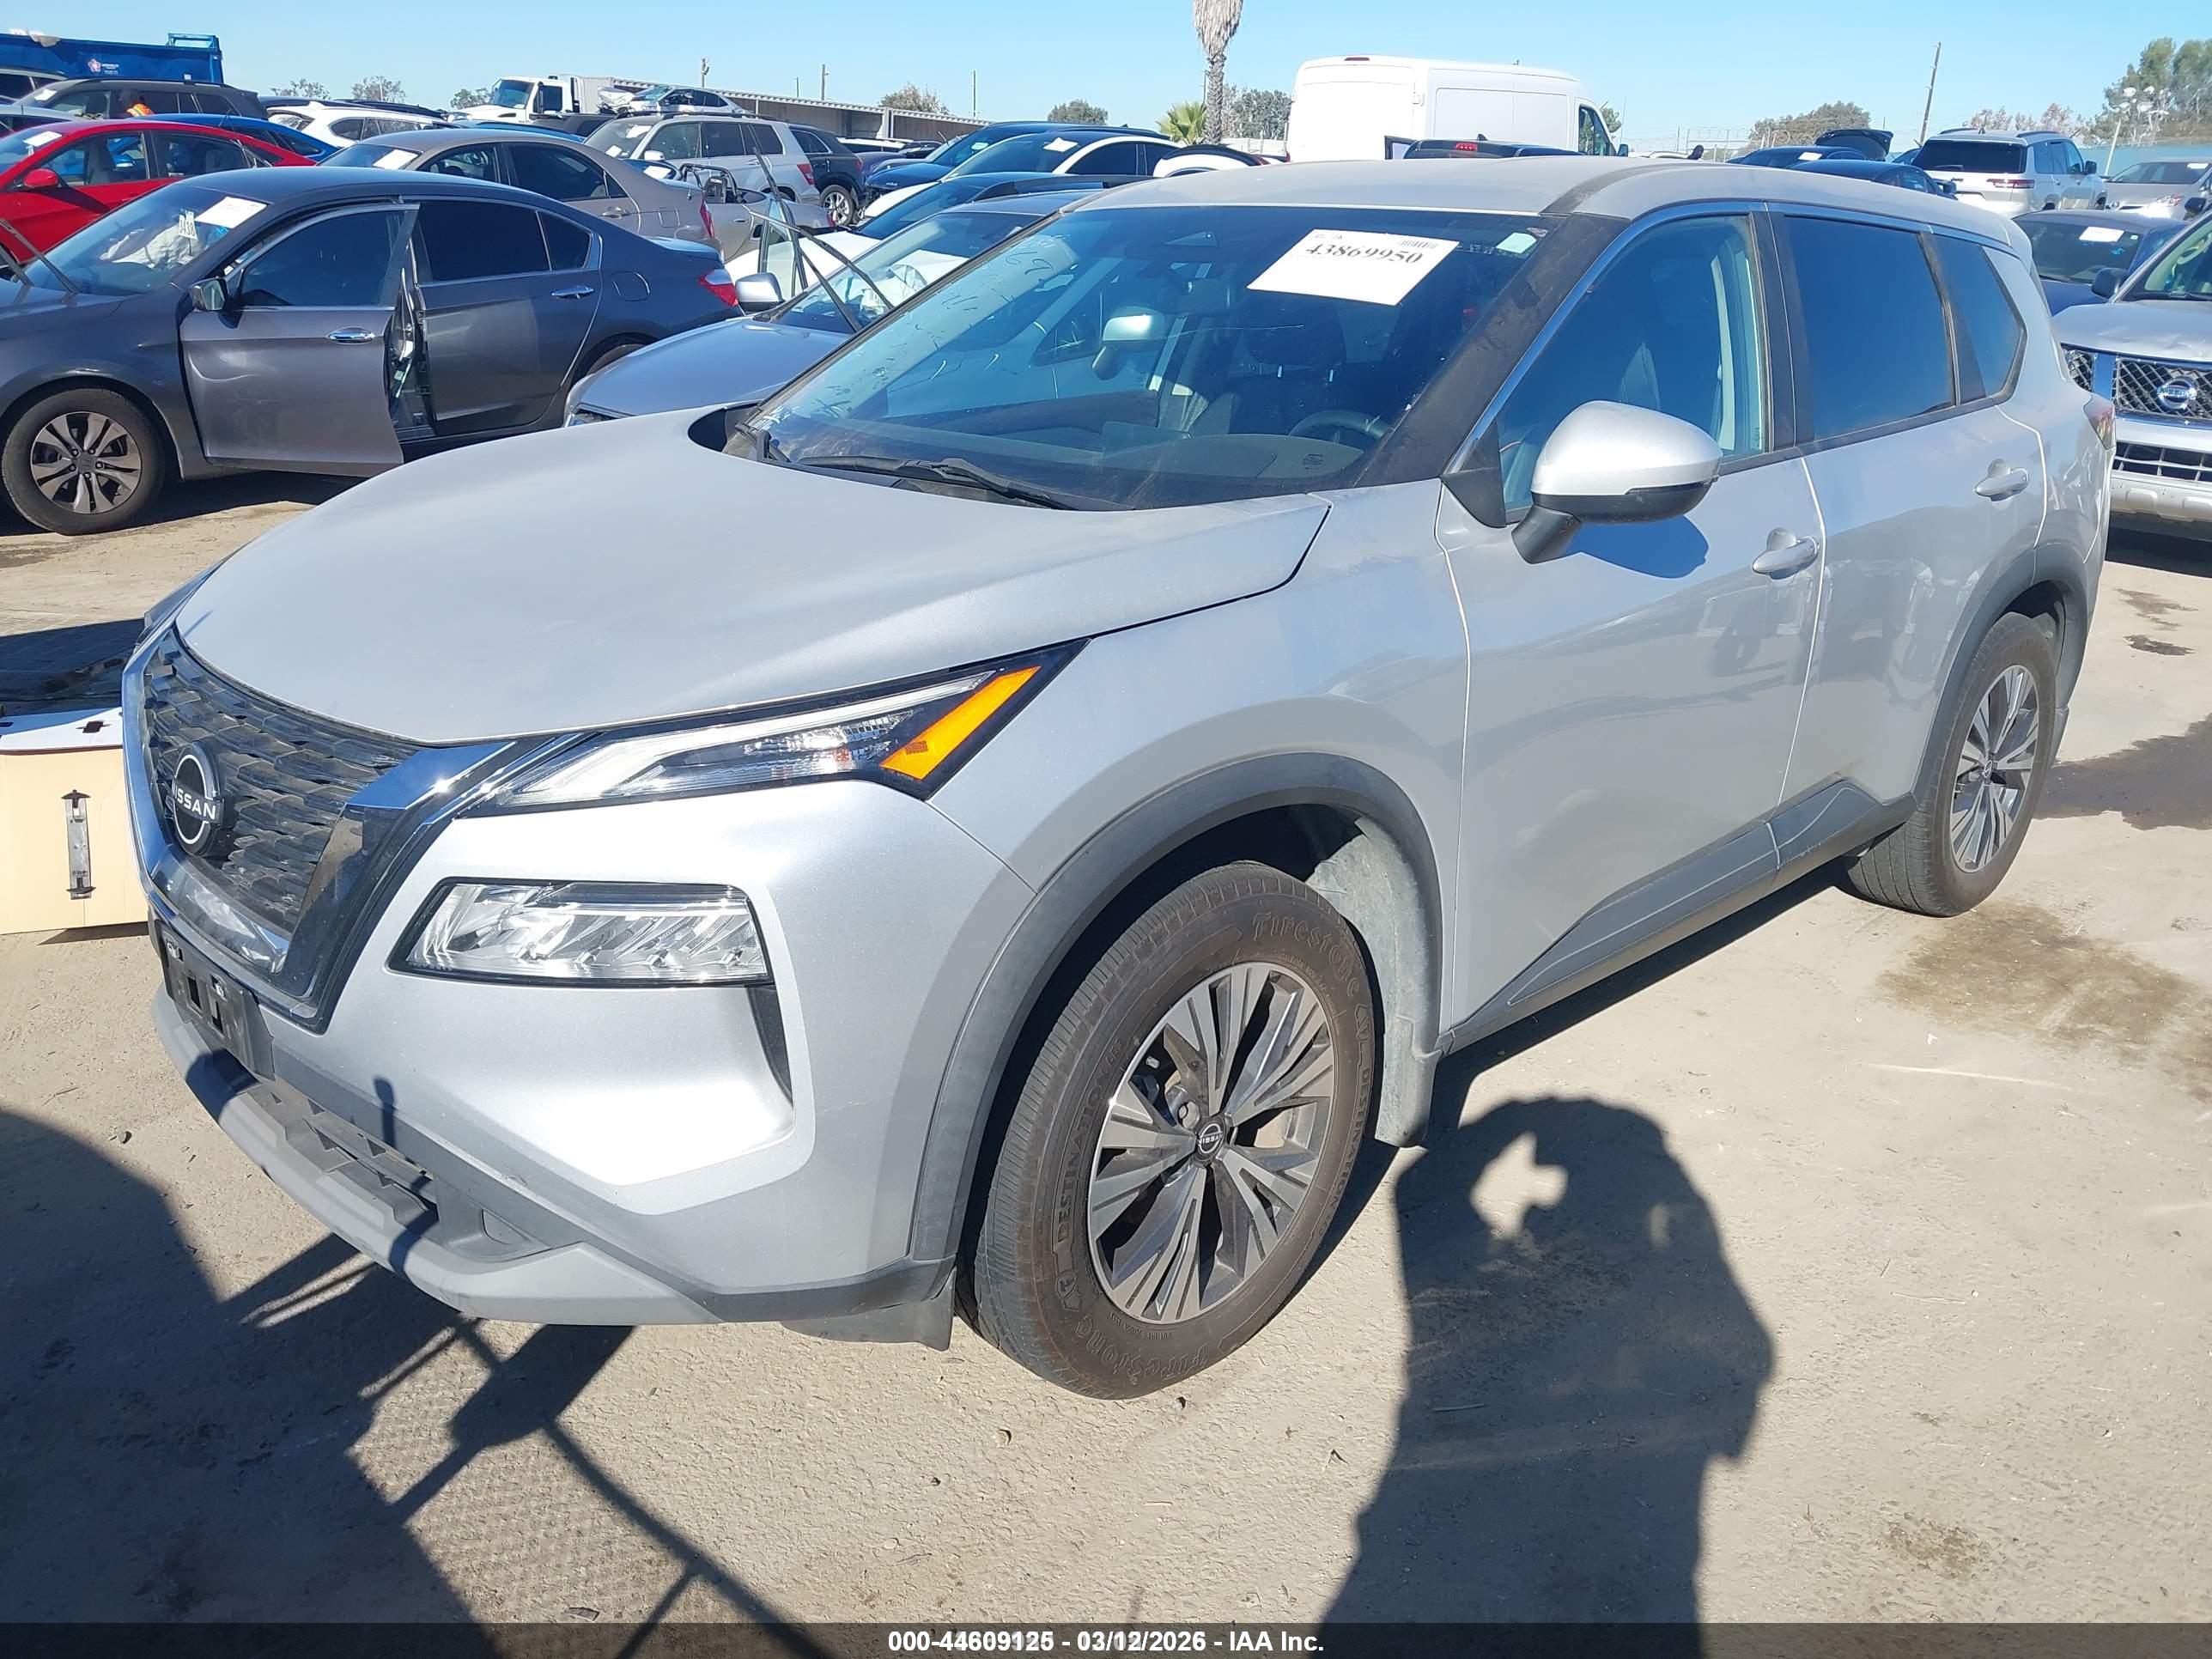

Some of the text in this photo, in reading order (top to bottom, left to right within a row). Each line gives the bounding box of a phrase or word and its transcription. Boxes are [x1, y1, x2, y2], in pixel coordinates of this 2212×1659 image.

[1306, 243, 1423, 264] 43869950
[172, 779, 216, 820] NISSAN
[1253, 911, 1361, 1001] Firestone
[1198, 1133, 1223, 1145] NISSAN
